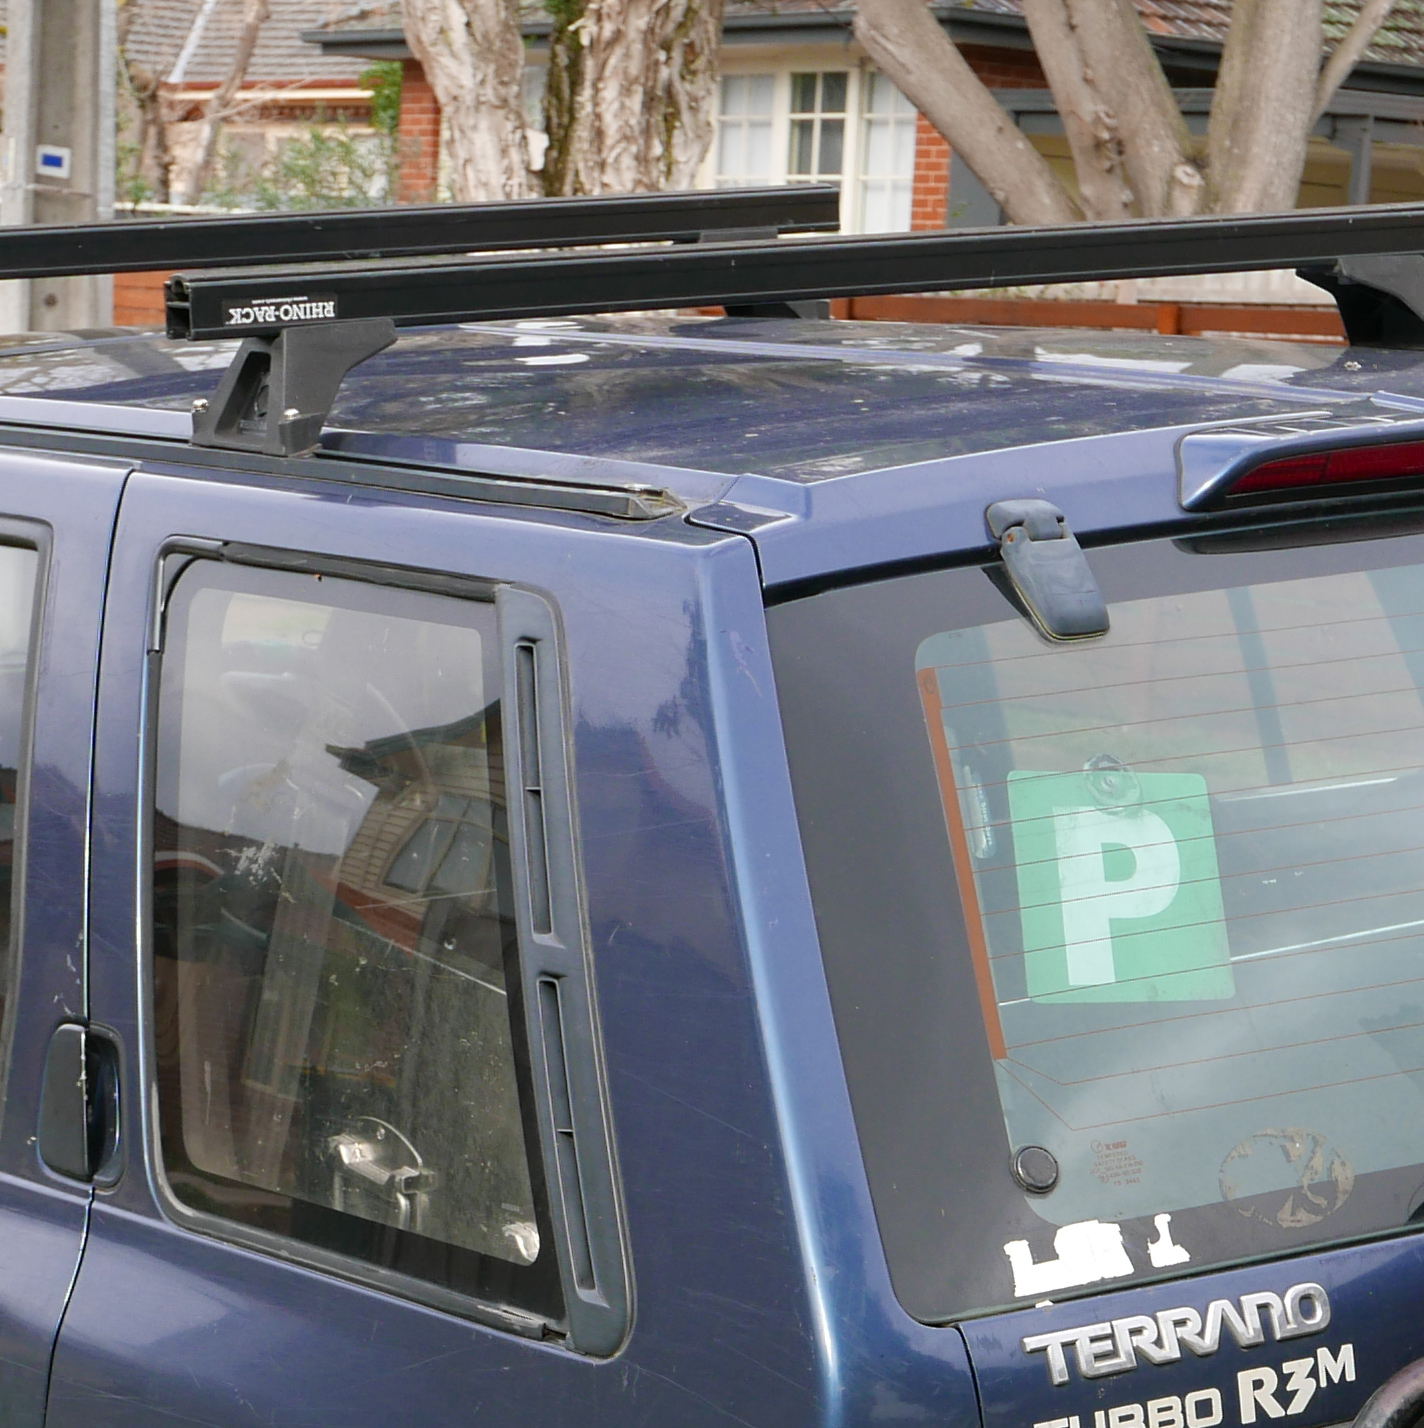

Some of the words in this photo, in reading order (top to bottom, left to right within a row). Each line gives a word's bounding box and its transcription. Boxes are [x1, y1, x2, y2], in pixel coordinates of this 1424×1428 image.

[228, 301, 335, 324] RHINO-RACK
[1052, 806, 1180, 985] P
[1022, 1282, 1330, 1386] TERRANO
[1237, 1344, 1356, 1425] R3M
